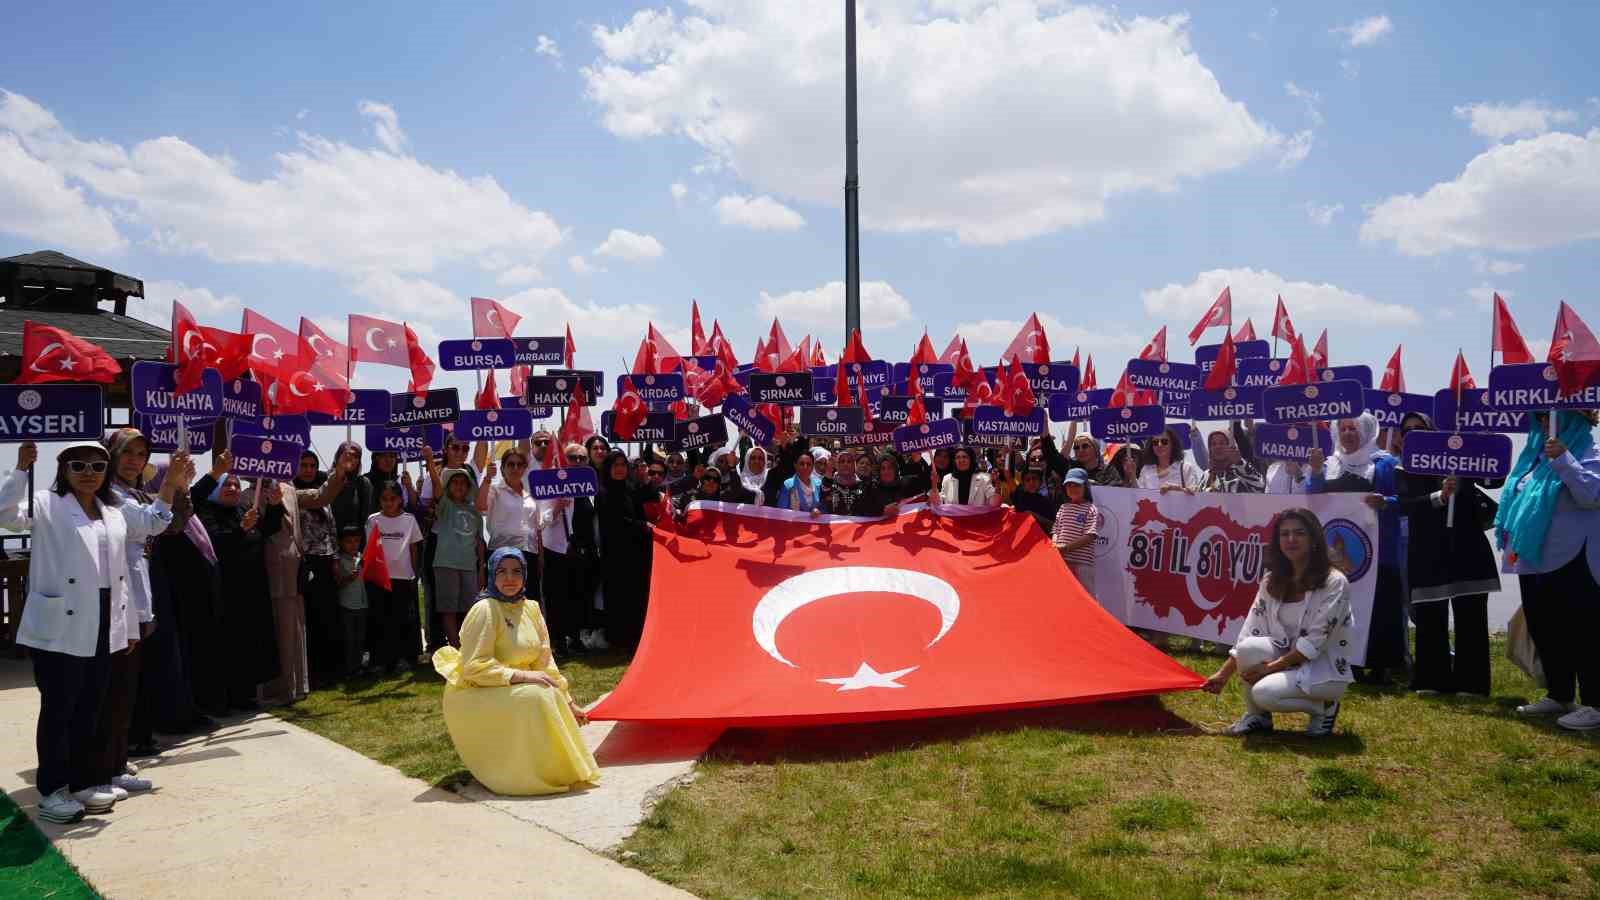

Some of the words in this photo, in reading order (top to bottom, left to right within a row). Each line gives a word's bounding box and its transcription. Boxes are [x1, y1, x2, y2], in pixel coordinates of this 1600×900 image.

[454, 354, 504, 367] BURSA
[515, 353, 561, 361] YARBAKIR
[1031, 377, 1068, 391] UĞLA
[1244, 374, 1282, 386] ANKA
[146, 386, 214, 411] KÜTAHYA
[534, 390, 589, 404] HAKKAİ
[637, 386, 678, 398] KİRDAĞ
[1495, 386, 1600, 406] KIRKLARE
[223, 397, 257, 417] RIKKALE
[1165, 404, 1187, 416] İZLİ
[1208, 401, 1255, 416] NİĞDE
[1275, 401, 1352, 420] TRABZON
[0, 410, 85, 434] AYSERİ
[390, 408, 453, 423] GAZİANTEP
[884, 411, 940, 422] ARDAN
[1456, 411, 1525, 427] HATAY
[471, 425, 515, 437] ORDU
[632, 428, 665, 439] RTIN
[816, 421, 848, 432] IĞDIR
[978, 420, 1040, 433] KASTAMONU
[151, 428, 207, 446] SAKRYA
[385, 437, 424, 449] KARS
[901, 432, 954, 451] BALIKESİR
[1262, 442, 1312, 458] KARAMA
[233, 456, 293, 475] ISPARTA
[1411, 452, 1499, 474] ESKİŞEHİR
[535, 482, 596, 497] MALATYA
[1130, 533, 1164, 571] 81
[1171, 529, 1191, 574] İL
[1197, 541, 1223, 578] 81
[1229, 534, 1264, 582] YÜ
